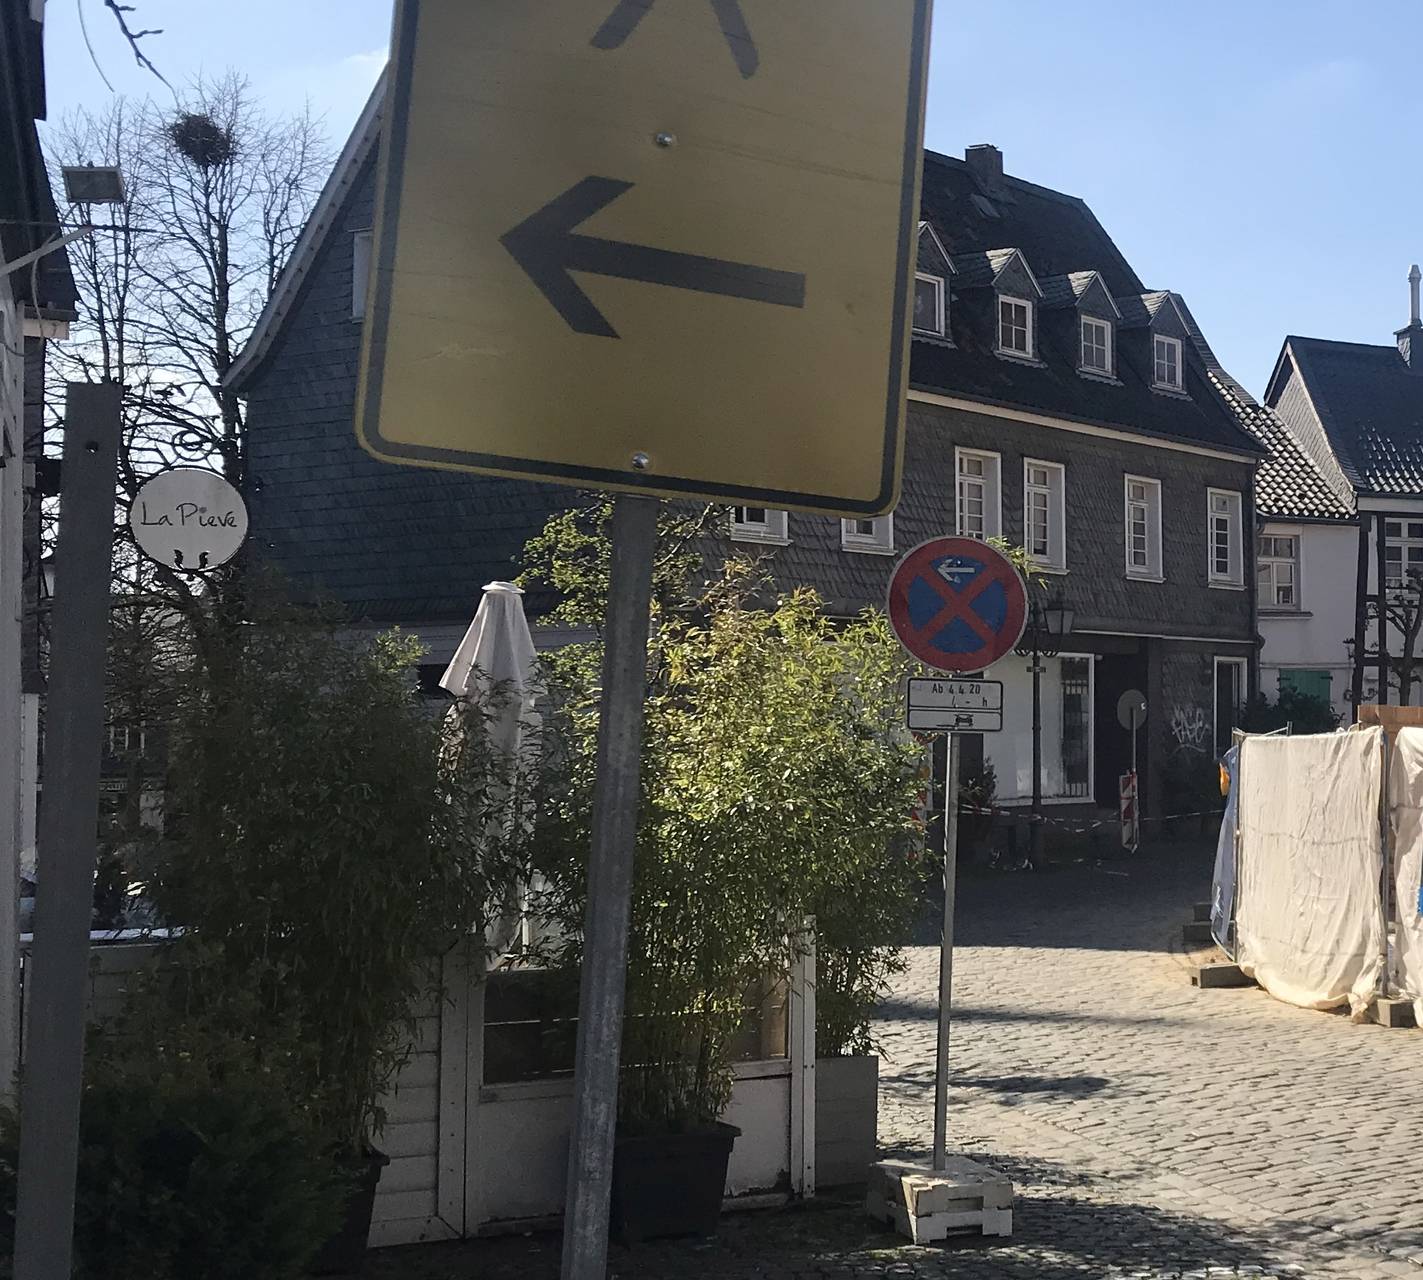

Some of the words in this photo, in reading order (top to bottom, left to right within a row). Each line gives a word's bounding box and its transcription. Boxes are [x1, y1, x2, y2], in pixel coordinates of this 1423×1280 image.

[140, 502, 173, 526] La
[175, 502, 238, 527] Pieve
[931, 683, 944, 694] Ab
[949, 684, 954, 695] 4
[958, 684, 965, 695] 4
[969, 683, 981, 694] 20
[982, 697, 988, 707] h
